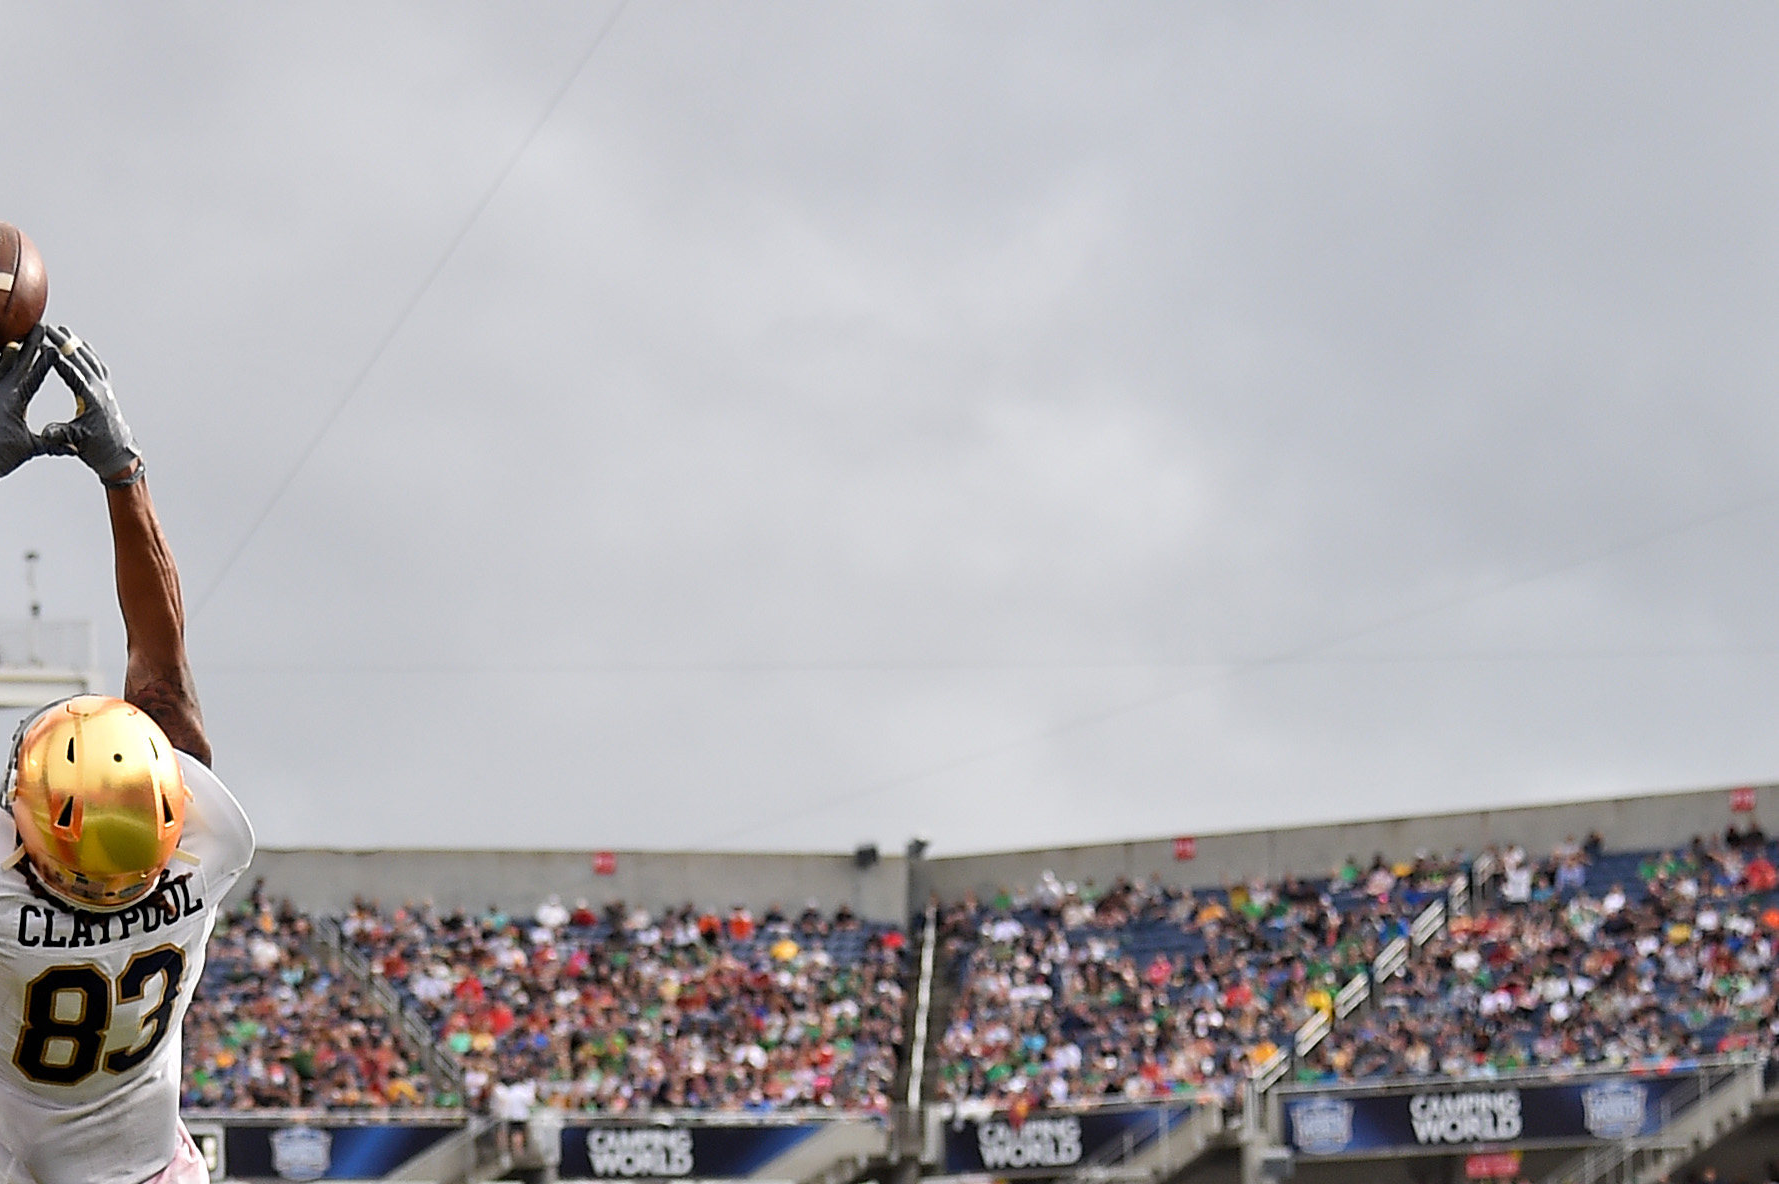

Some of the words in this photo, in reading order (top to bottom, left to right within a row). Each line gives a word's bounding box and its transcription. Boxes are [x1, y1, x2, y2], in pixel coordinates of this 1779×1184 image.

[12, 942, 187, 1087] 83
[1409, 1090, 1521, 1121] CAMPING
[586, 1128, 693, 1155] CAMPING
[1412, 1114, 1521, 1145] WORLD
[588, 1149, 694, 1177] WORLD
[979, 1141, 1083, 1169] WORLD
